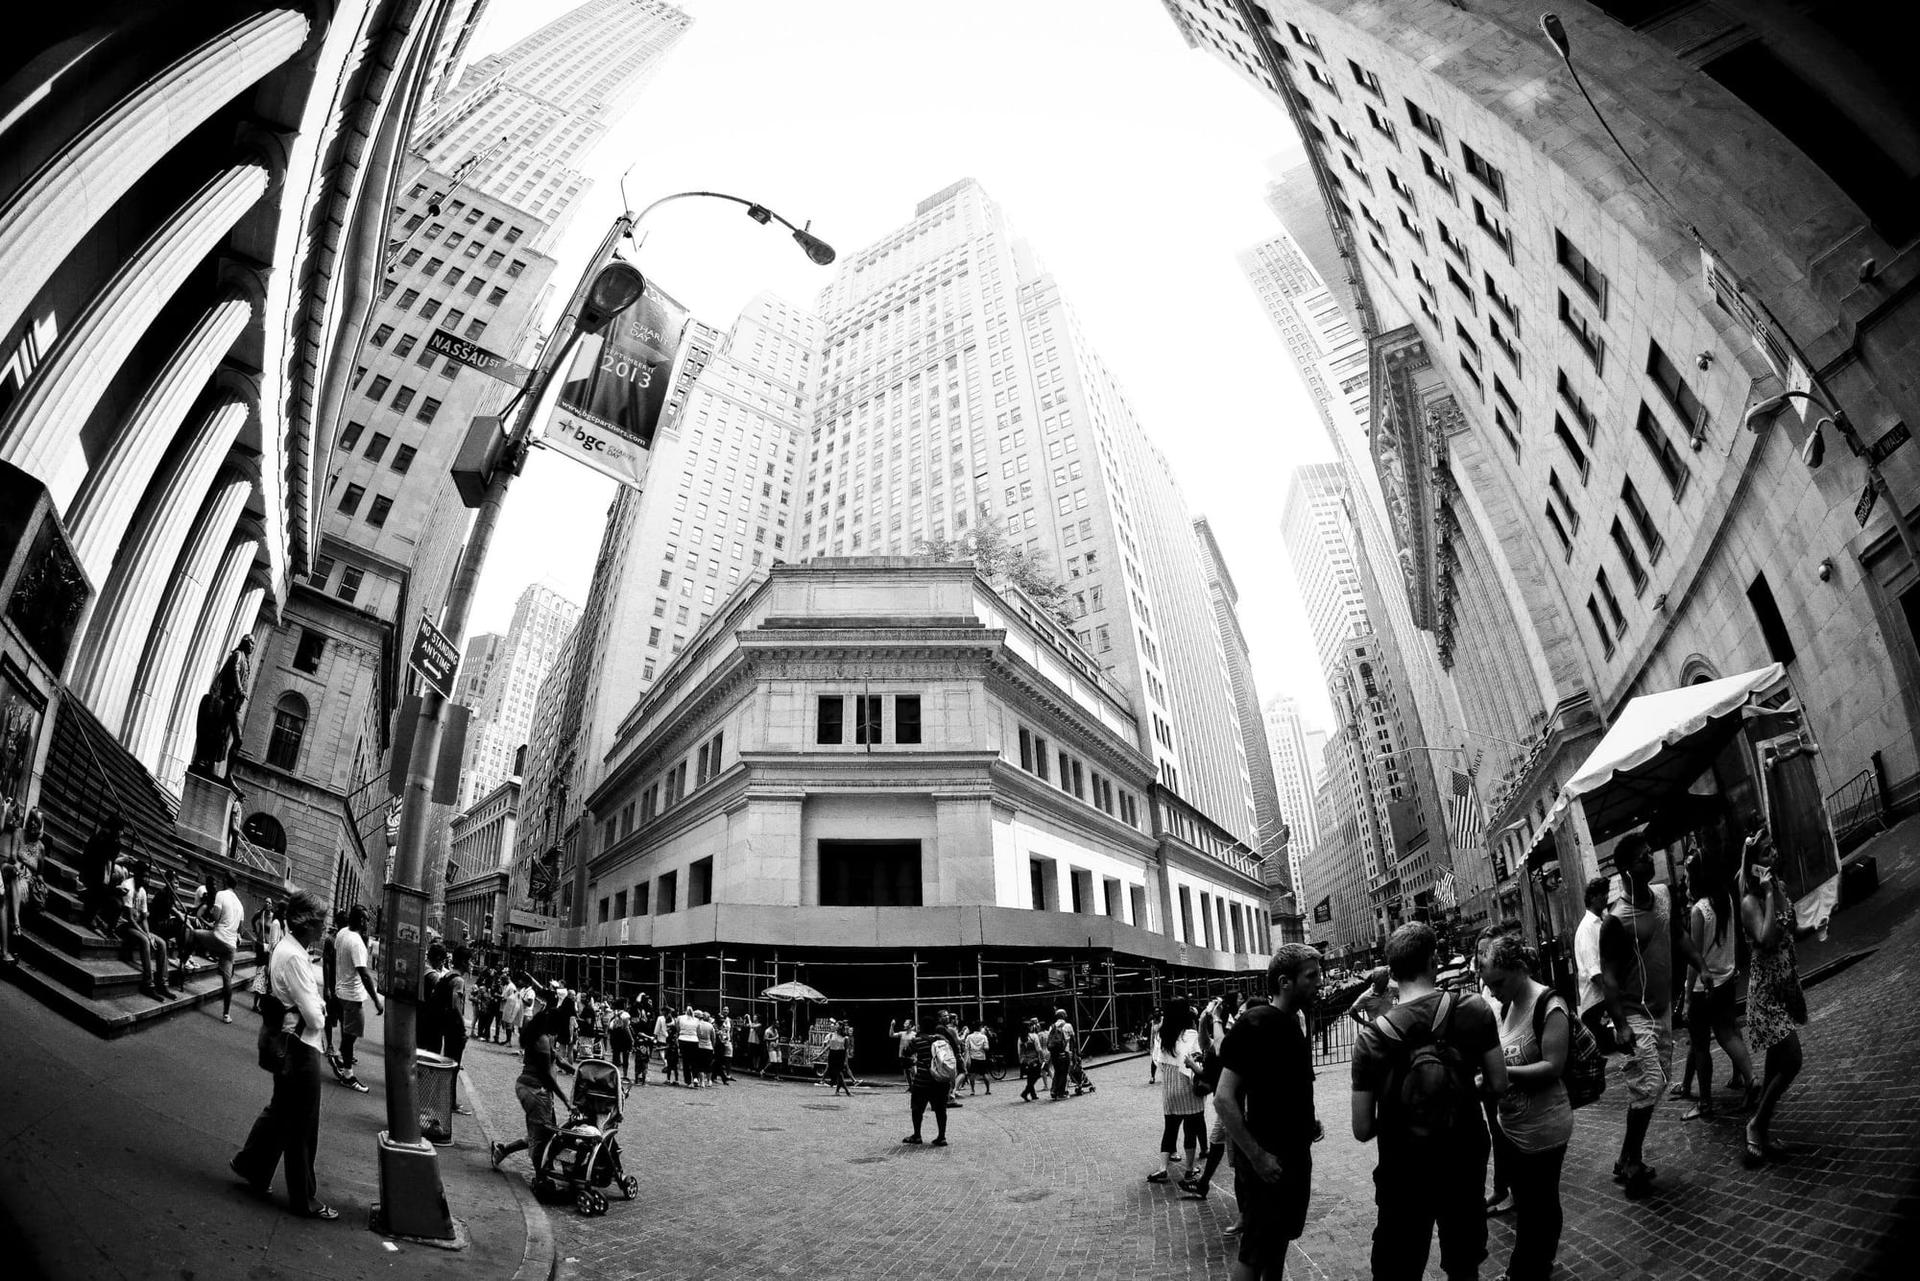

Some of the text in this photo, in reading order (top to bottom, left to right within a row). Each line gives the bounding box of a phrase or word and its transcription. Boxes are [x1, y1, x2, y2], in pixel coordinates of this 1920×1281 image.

[431, 335, 501, 369] NASSAU ST
[630, 329, 651, 342] DAY
[600, 355, 652, 389] 2013
[561, 400, 646, 447] www.bgcpartners.com
[573, 425, 606, 451] bgc
[421, 640, 451, 674] ANYTIME
[422, 622, 459, 665] NO STANDING
